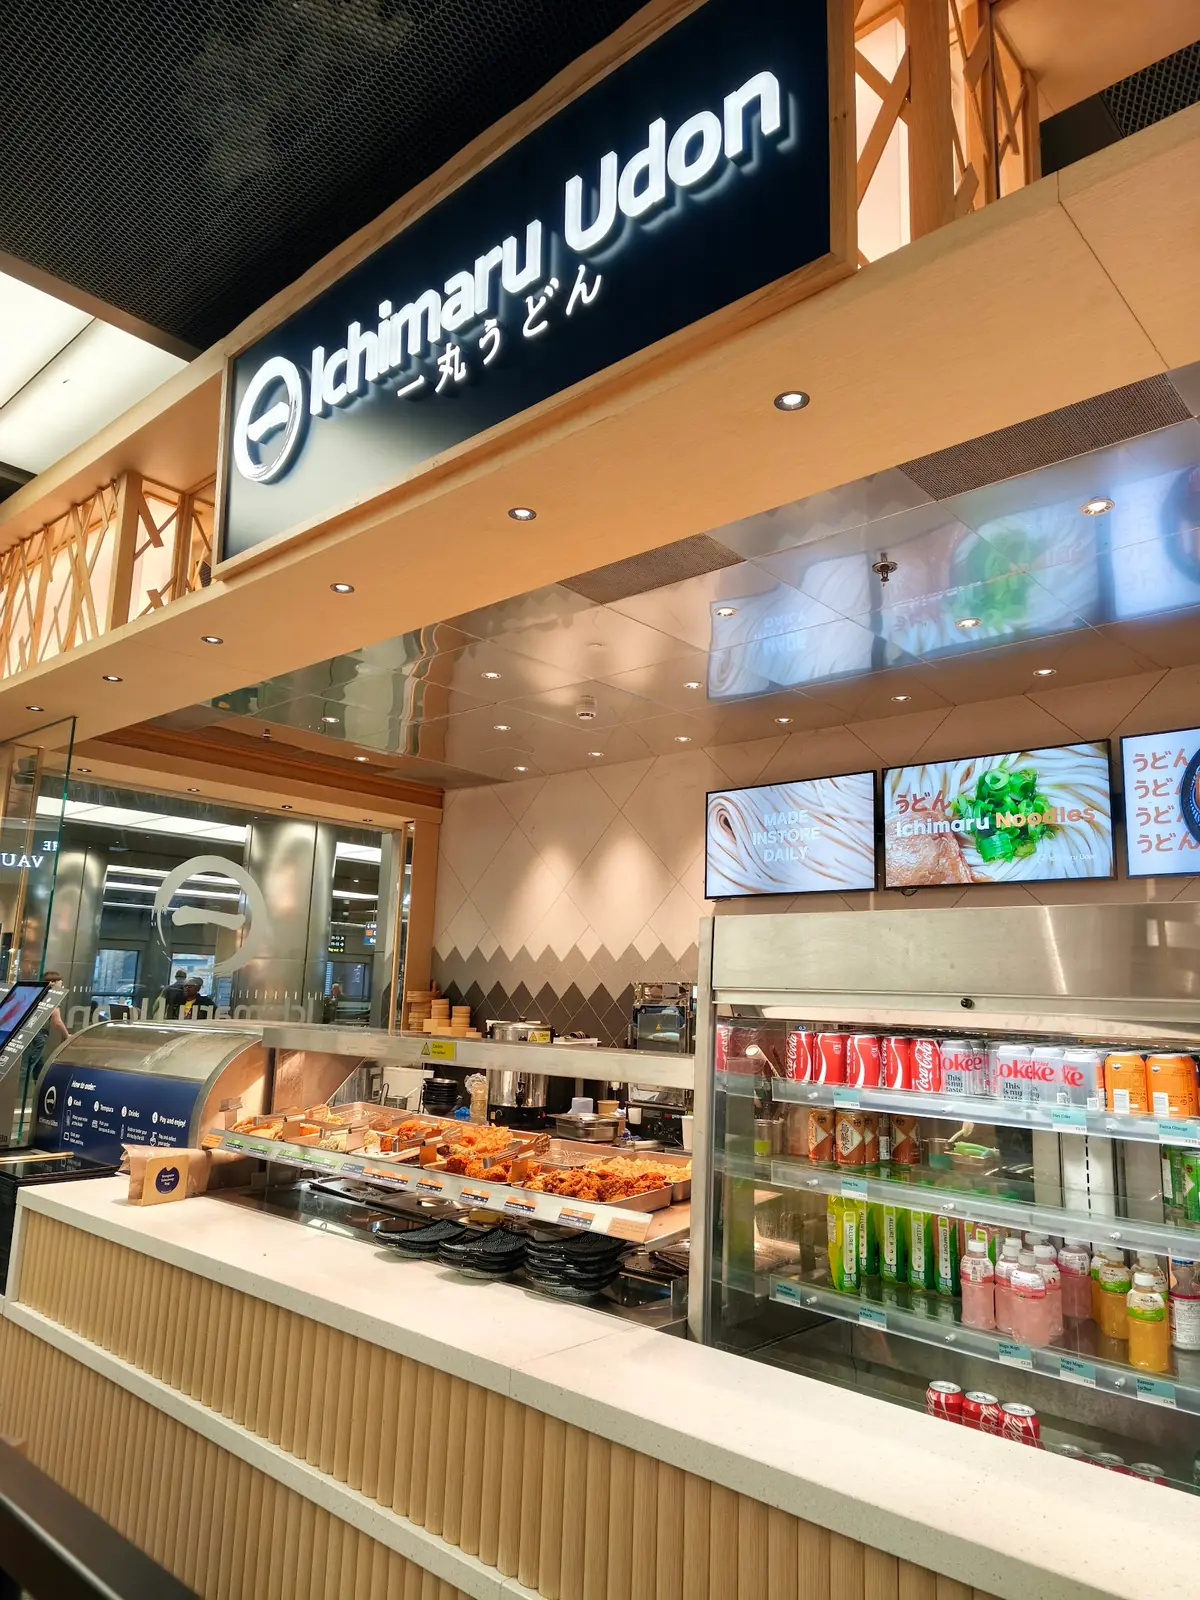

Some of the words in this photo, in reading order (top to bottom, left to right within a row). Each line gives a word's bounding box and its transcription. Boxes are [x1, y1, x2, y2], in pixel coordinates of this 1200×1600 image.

[309, 219, 542, 416] Ichimaru
[564, 71, 781, 252] Udon
[397, 264, 602, 398] 一丸うどん
[895, 790, 952, 814] うどん
[763, 810, 809, 827] MADE
[896, 815, 990, 837] Ichimaru
[995, 806, 1096, 829] Noodles
[1136, 805, 1183, 826] うど
[752, 827, 821, 845] INSTORE
[763, 846, 808, 862] DAILY
[71, 1080, 80, 1088] How
[1004, 1082, 1021, 1090] This
[100, 1104, 114, 1113] Tempura
[128, 1109, 140, 1118] Drinks
